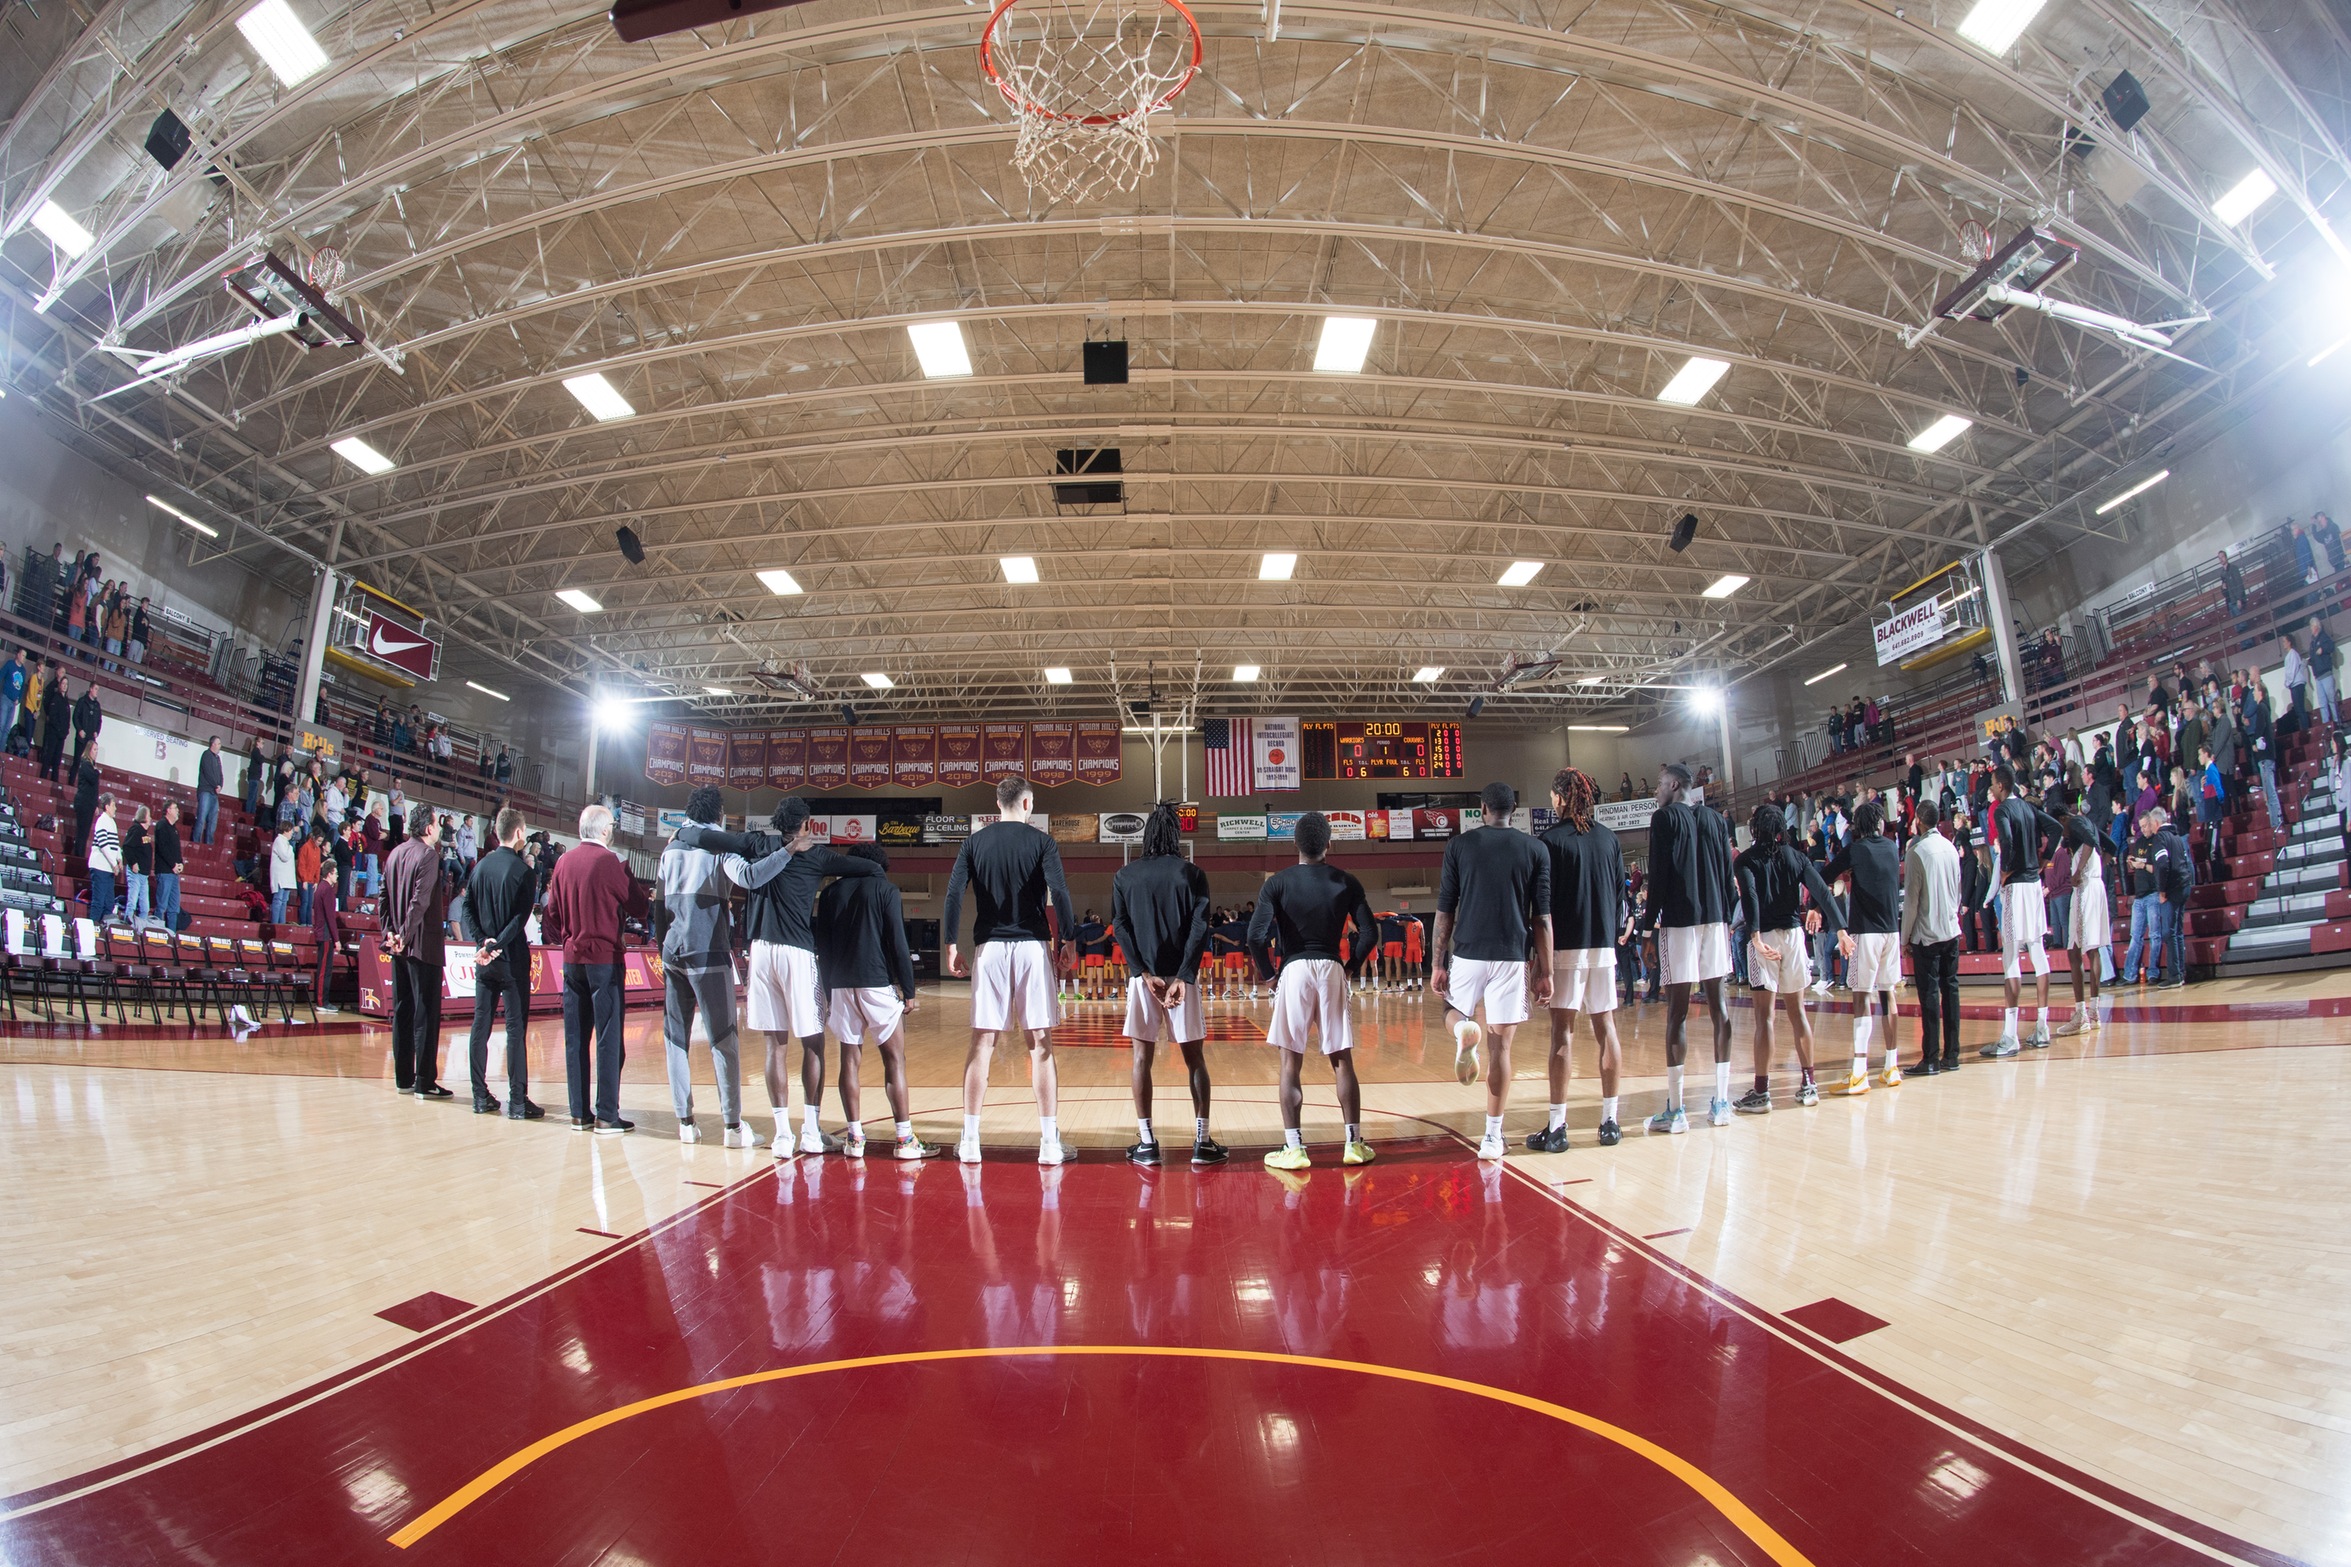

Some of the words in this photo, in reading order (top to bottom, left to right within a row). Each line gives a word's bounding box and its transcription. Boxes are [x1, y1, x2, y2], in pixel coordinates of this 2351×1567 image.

[2128, 587, 2148, 600] BALCONY
[1877, 603, 1935, 643] BLACKWELL
[653, 722, 671, 733] INDIAN
[671, 725, 687, 736] HILLS
[895, 727, 916, 735] INDIAN
[917, 726, 934, 735] HILLS
[940, 725, 961, 733] INDIAN
[962, 725, 980, 733] HILLS
[985, 725, 1007, 733] INDIAN
[1007, 724, 1024, 733] HILLS
[1032, 723, 1054, 732] INDIAN
[1054, 723, 1073, 731] HILLS
[1078, 723, 1100, 731] INDIAN
[1101, 722, 1119, 731] HILLS
[1264, 723, 1286, 731] NATIONAL
[1366, 722, 1400, 735] 20:00
[692, 728, 710, 739] INDIAN
[711, 731, 727, 740] HILLS
[750, 732, 766, 740] HILLS
[770, 731, 789, 739] INDIAN
[789, 730, 806, 738] HILLS
[810, 729, 830, 737] INDIAN
[830, 728, 848, 736] HILLS
[852, 728, 873, 736] INDIAN
[873, 728, 891, 736] HILLS
[1256, 731, 1295, 739] INTERCOLLEGIATE
[1436, 729, 1442, 737] 2
[1443, 729, 1449, 737] 0
[1454, 729, 1460, 737] 0
[165, 735, 188, 748] SEATING
[296, 730, 305, 738] GO
[302, 731, 335, 756] Hills
[1434, 737, 1442, 745] 13
[1443, 737, 1449, 745] 0
[1455, 737, 1460, 745] 0
[155, 740, 167, 760] B
[1354, 744, 1362, 757] 0
[1384, 746, 1388, 755] 1
[1417, 744, 1424, 756] 0
[1434, 745, 1443, 753] 15
[1444, 745, 1450, 753] 0
[1455, 745, 1461, 753] 0
[1433, 753, 1443, 761] 23
[1444, 753, 1450, 761] 0
[649, 757, 684, 773] CHAMPIONS
[851, 763, 889, 775] CHAMPIONS
[894, 762, 934, 774] CHAMPIONS
[939, 761, 979, 774] CHAMPIONS
[984, 760, 1024, 773] CHAMPIONS
[1032, 759, 1073, 772] CHAMPIONS
[1078, 758, 1119, 771] CHAMPIONS
[1433, 761, 1444, 769] 24
[1445, 761, 1451, 769] 0
[654, 770, 677, 778] 2021
[689, 763, 725, 778] CHAMPIONS
[729, 766, 764, 779] CHAMPIONS
[768, 765, 804, 778] CHAMPIONS
[809, 764, 846, 776] CHAMPIONS
[1347, 767, 1354, 777] 0
[1360, 766, 1367, 777] 6
[1403, 766, 1410, 777] 6
[1419, 766, 1426, 777] 0
[1445, 769, 1451, 777] 0
[694, 775, 720, 784] 2022
[1039, 771, 1065, 779] 1998
[1599, 804, 1628, 815] HINDMAN
[1631, 800, 1659, 812] PERSON
[1367, 811, 1379, 819] olé
[1465, 809, 1482, 818] NO
[1545, 809, 1559, 818] TE
[1629, 811, 1654, 819] CONDITIONIN
[925, 815, 955, 823] FLOOR
[1051, 819, 1082, 827] WAREHOUSE
[1271, 816, 1299, 826] SCHRO
[1438, 817, 1445, 826] C
[926, 824, 935, 832] to
[937, 824, 969, 832] CEILING
[1220, 820, 1265, 829] RICHWELL
[878, 822, 921, 838] Barbecue
